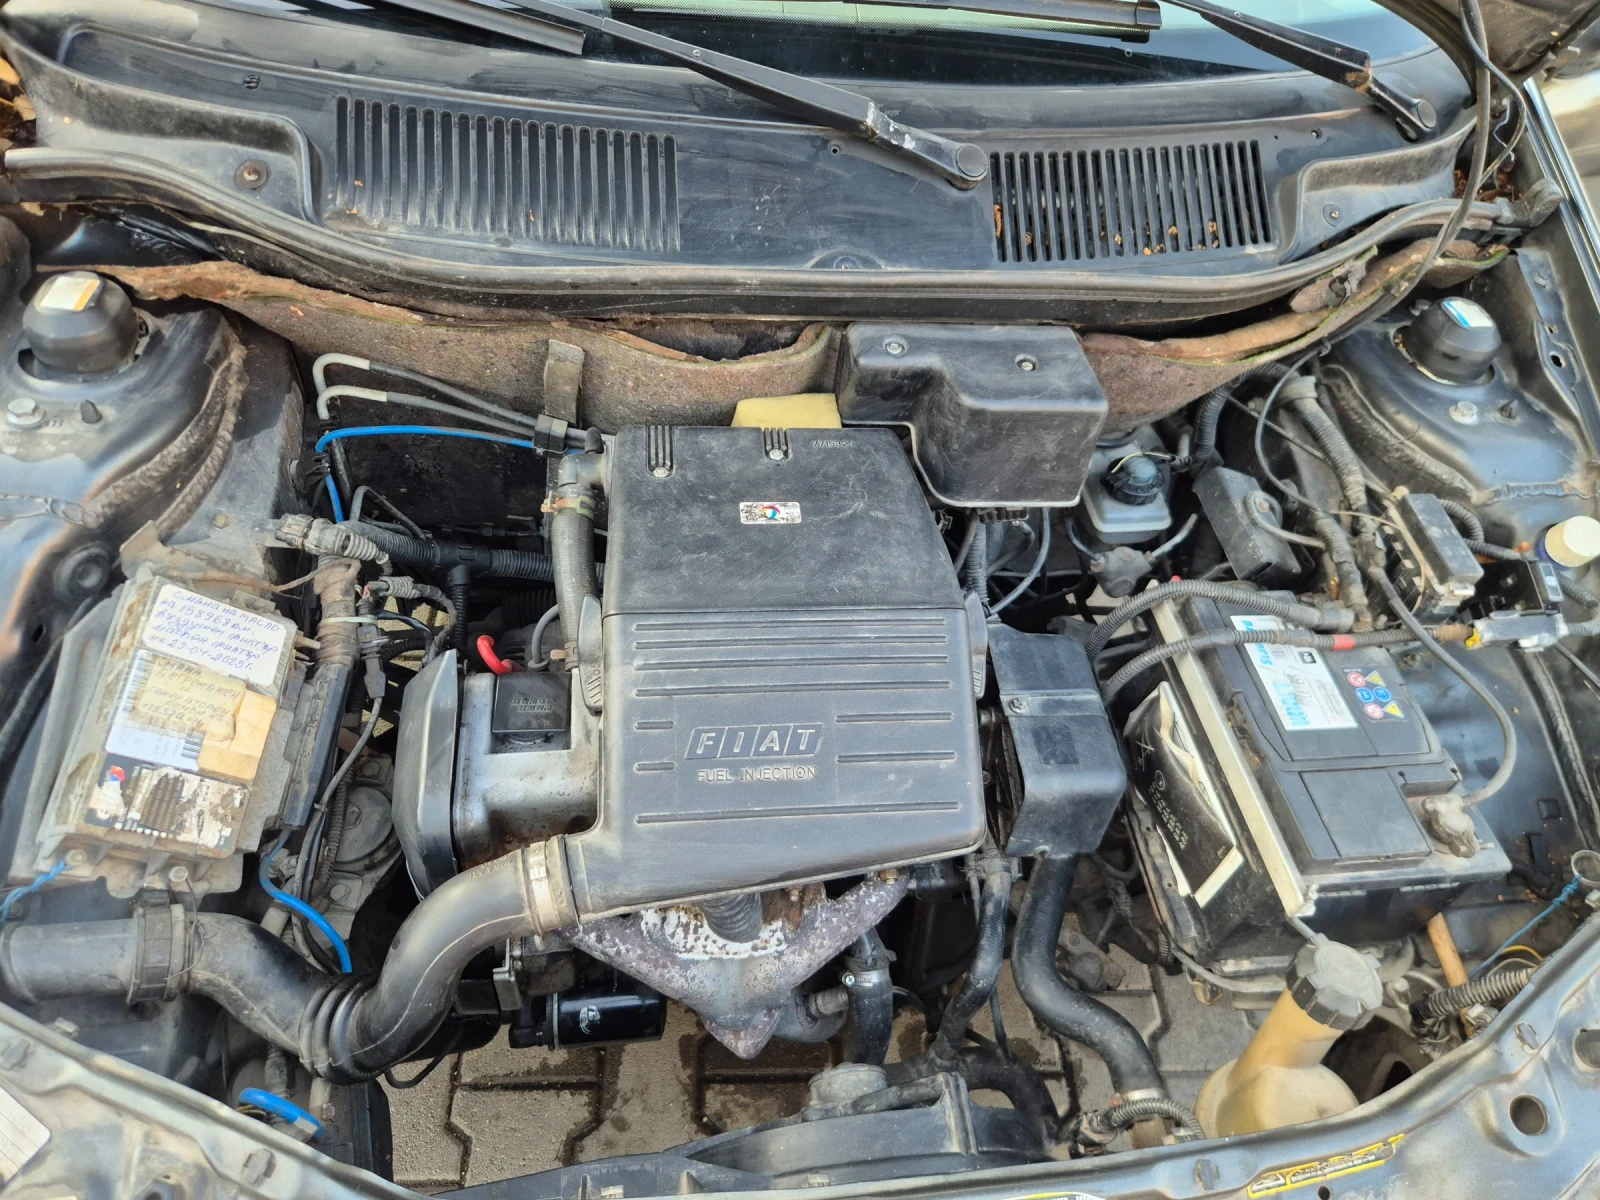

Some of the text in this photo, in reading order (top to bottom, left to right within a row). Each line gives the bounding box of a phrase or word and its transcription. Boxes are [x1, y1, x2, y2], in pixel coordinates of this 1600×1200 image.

[696, 729, 816, 755] FIAT
[698, 765, 817, 782] FUEL INJECTION
